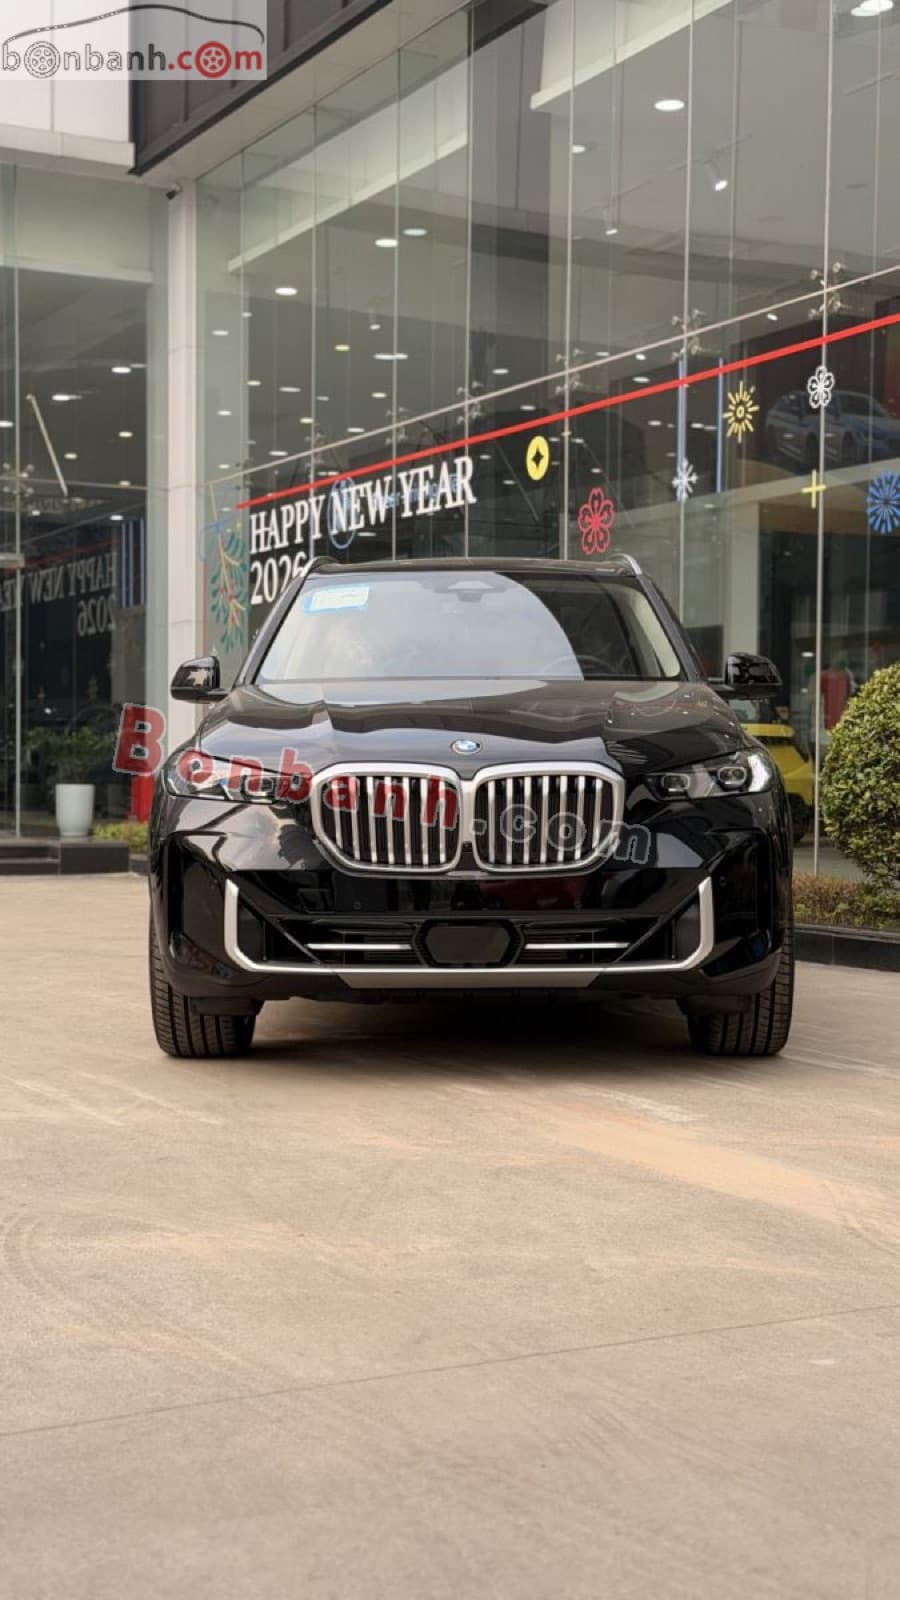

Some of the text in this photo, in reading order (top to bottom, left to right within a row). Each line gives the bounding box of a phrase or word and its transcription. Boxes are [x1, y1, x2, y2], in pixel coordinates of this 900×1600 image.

[250, 495, 325, 554] HAPPY
[328, 475, 393, 536] NEW
[397, 456, 477, 518] YEAR
